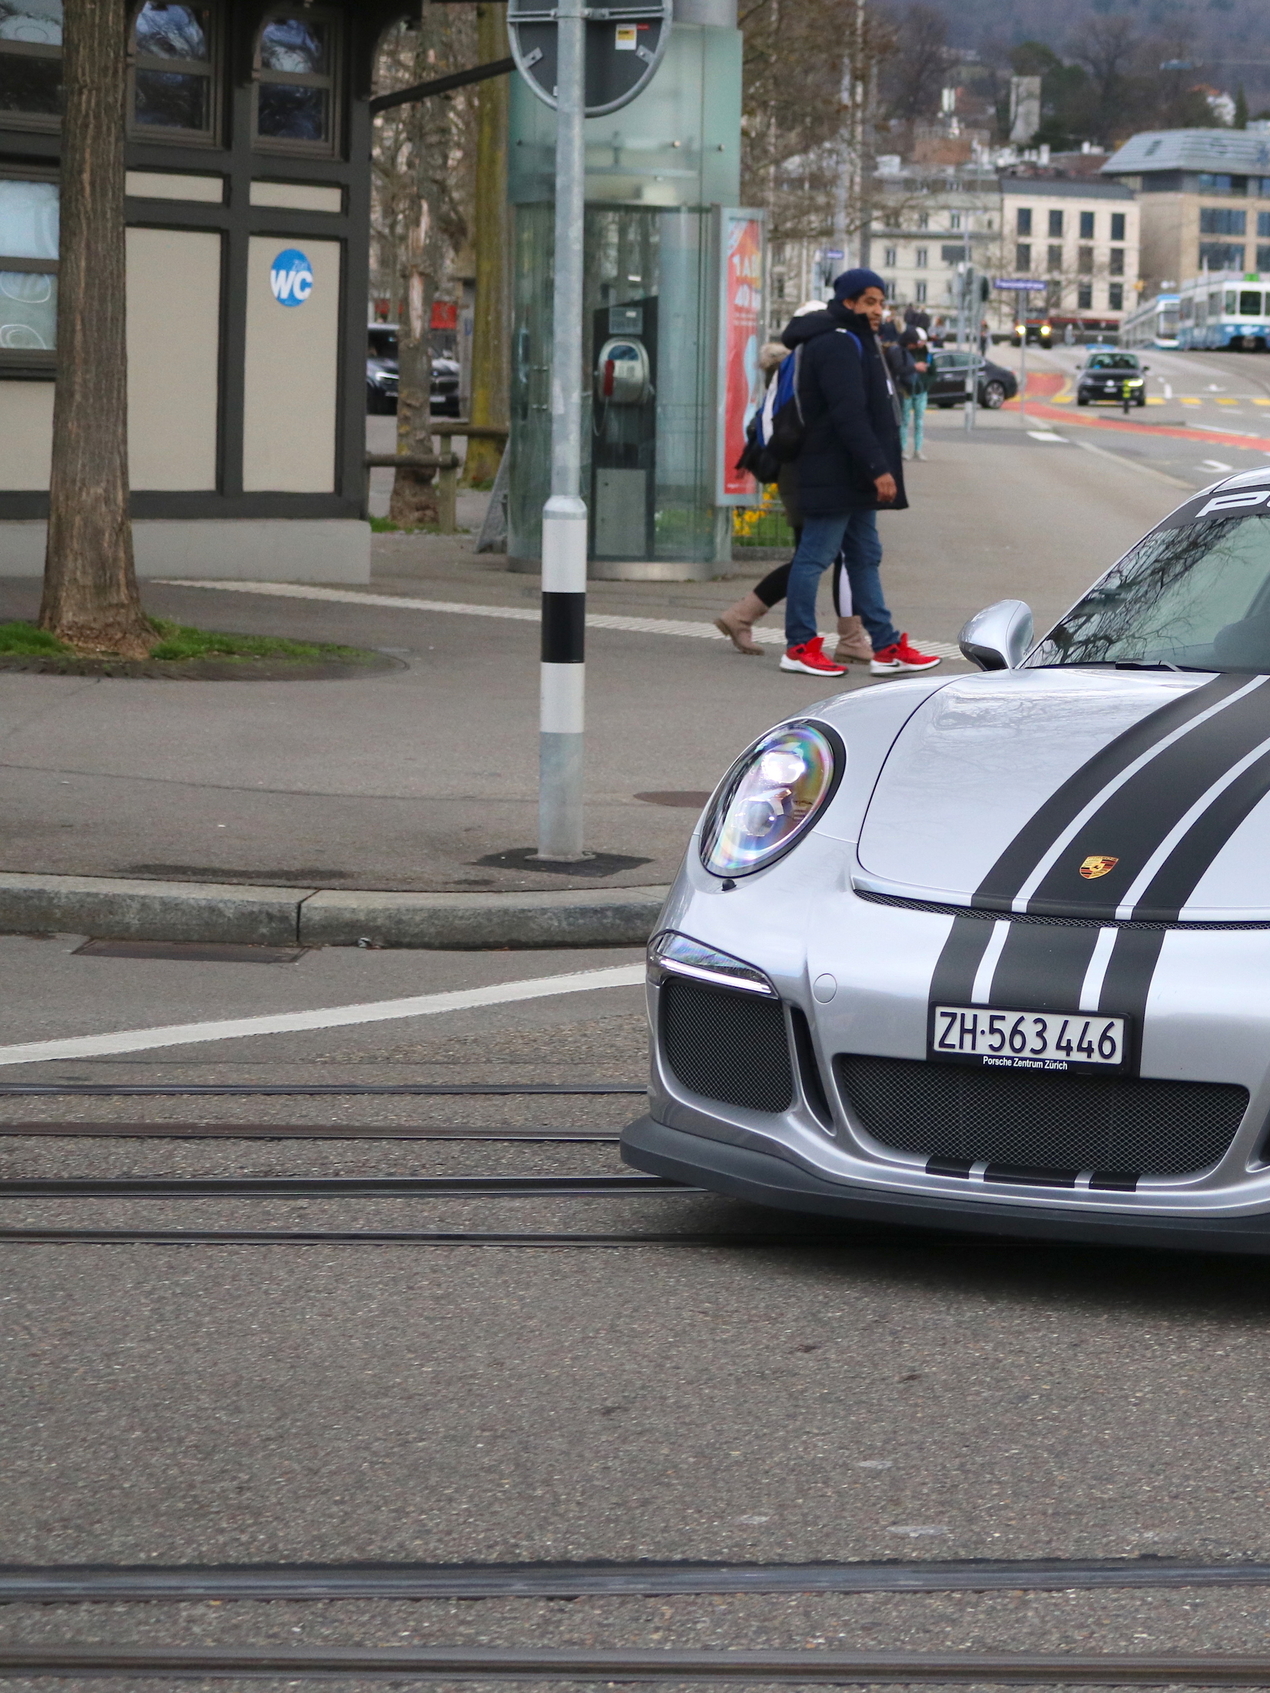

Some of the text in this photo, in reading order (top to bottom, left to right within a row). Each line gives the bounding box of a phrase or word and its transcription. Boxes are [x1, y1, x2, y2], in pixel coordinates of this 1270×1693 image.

[271, 269, 313, 300] WC
[983, 1055, 1068, 1070] Porsche Zentrum Zürich
